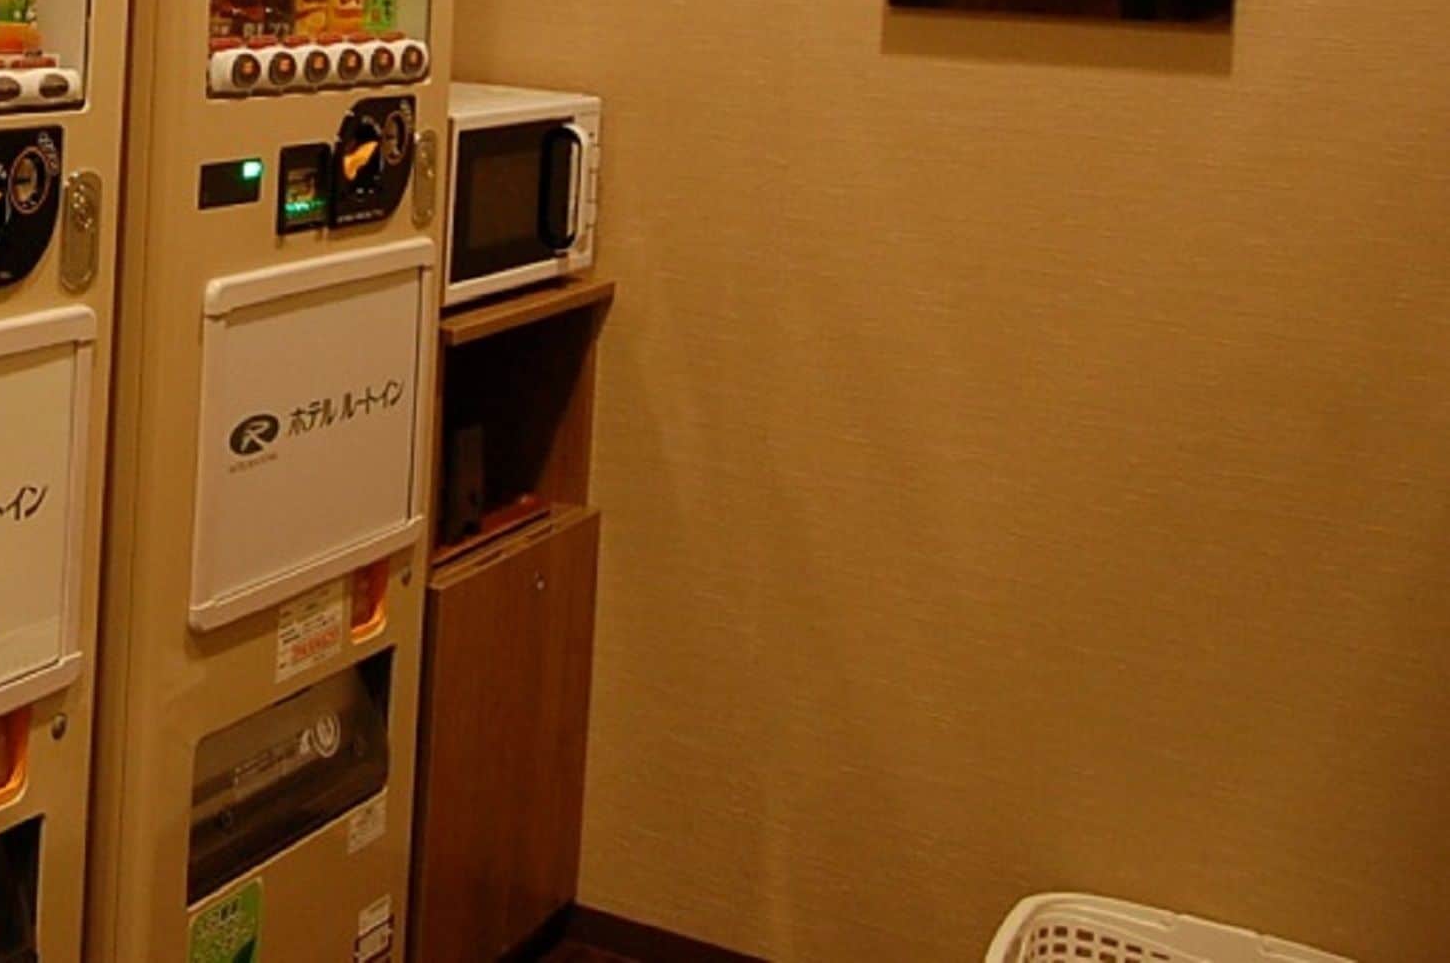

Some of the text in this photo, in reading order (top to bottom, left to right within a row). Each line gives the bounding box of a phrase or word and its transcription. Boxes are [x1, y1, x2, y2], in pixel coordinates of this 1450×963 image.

[288, 379, 405, 436] ホテル ルートイン
